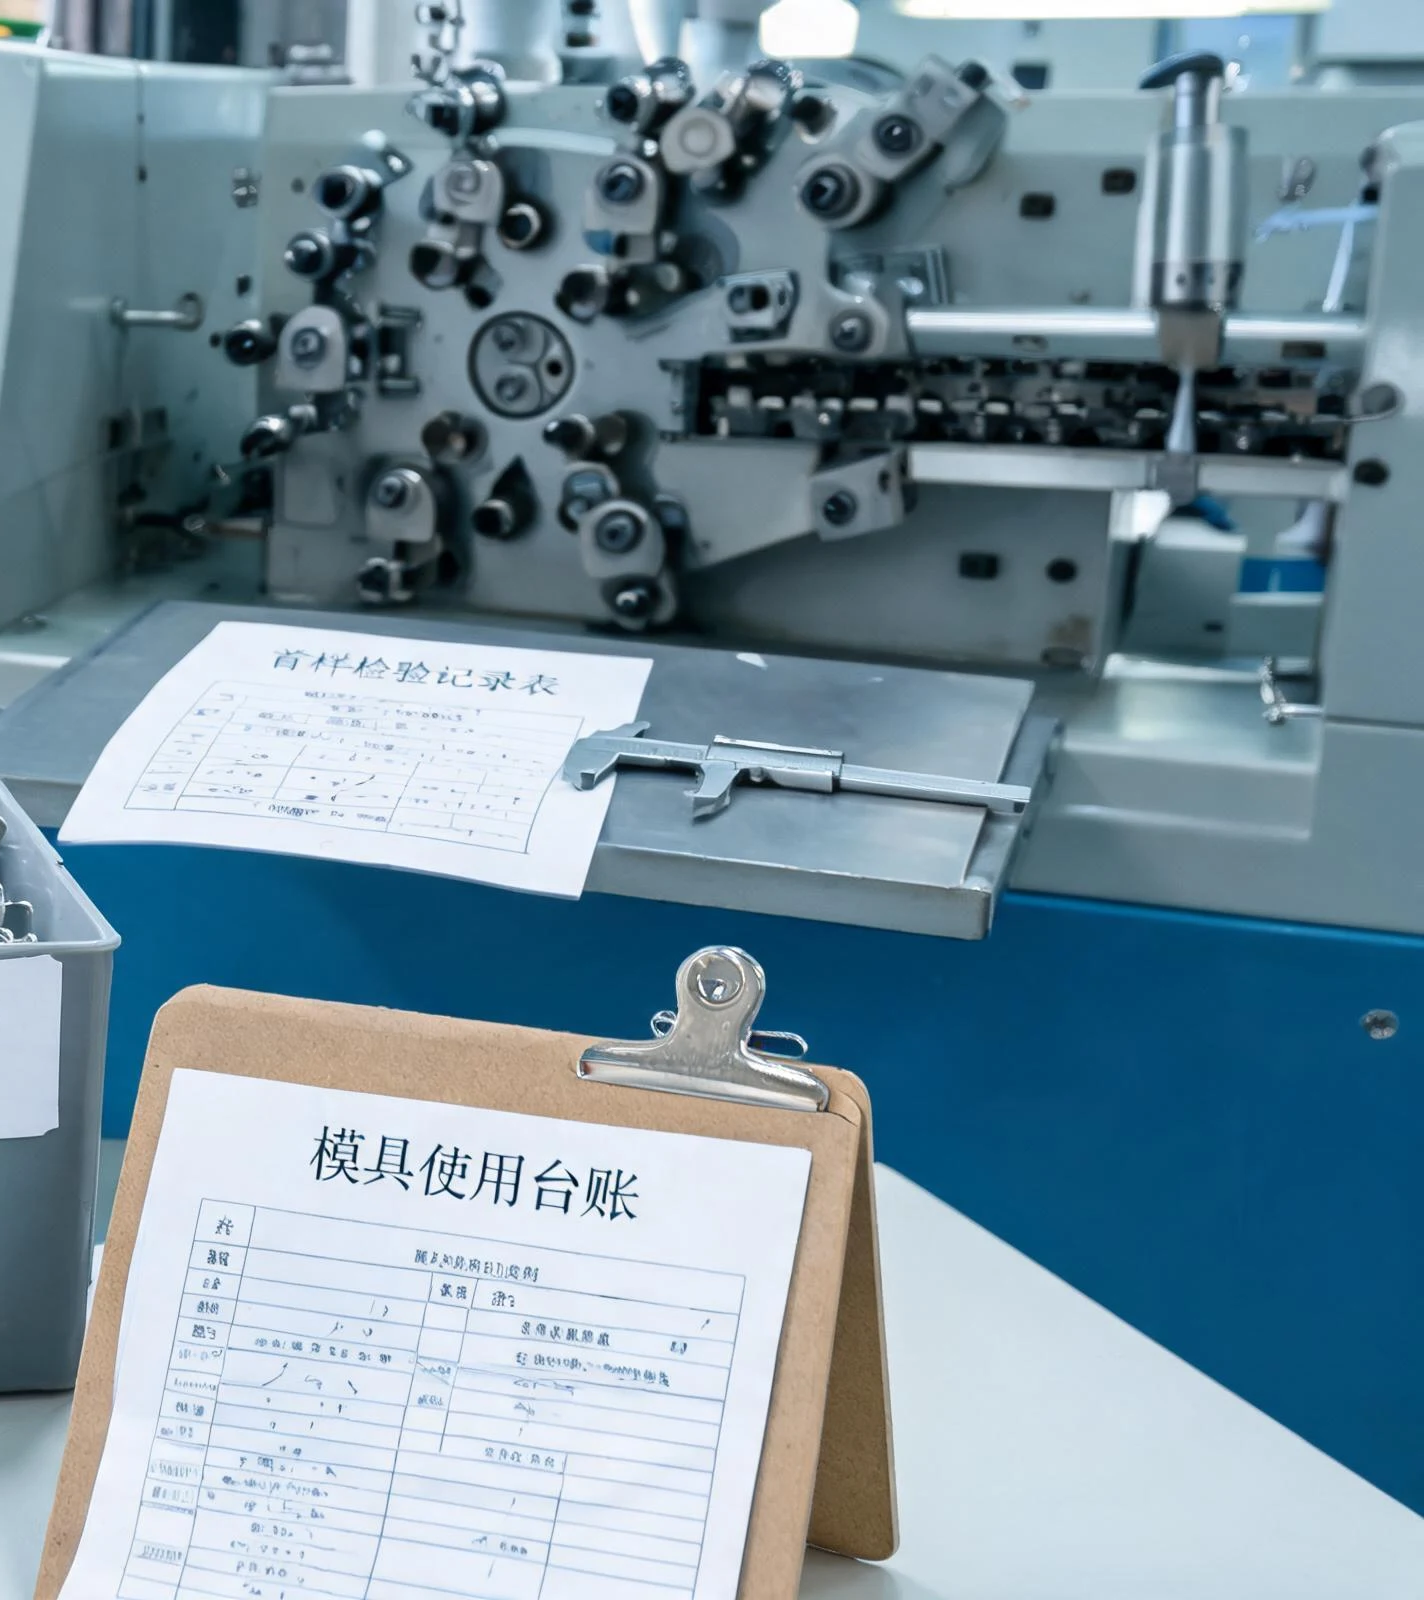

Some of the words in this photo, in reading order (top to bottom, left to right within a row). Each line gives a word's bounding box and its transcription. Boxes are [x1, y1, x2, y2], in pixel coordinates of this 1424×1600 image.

[274, 647, 559, 695] 首样检验记录表
[310, 1126, 639, 1221] 模具使用台账
